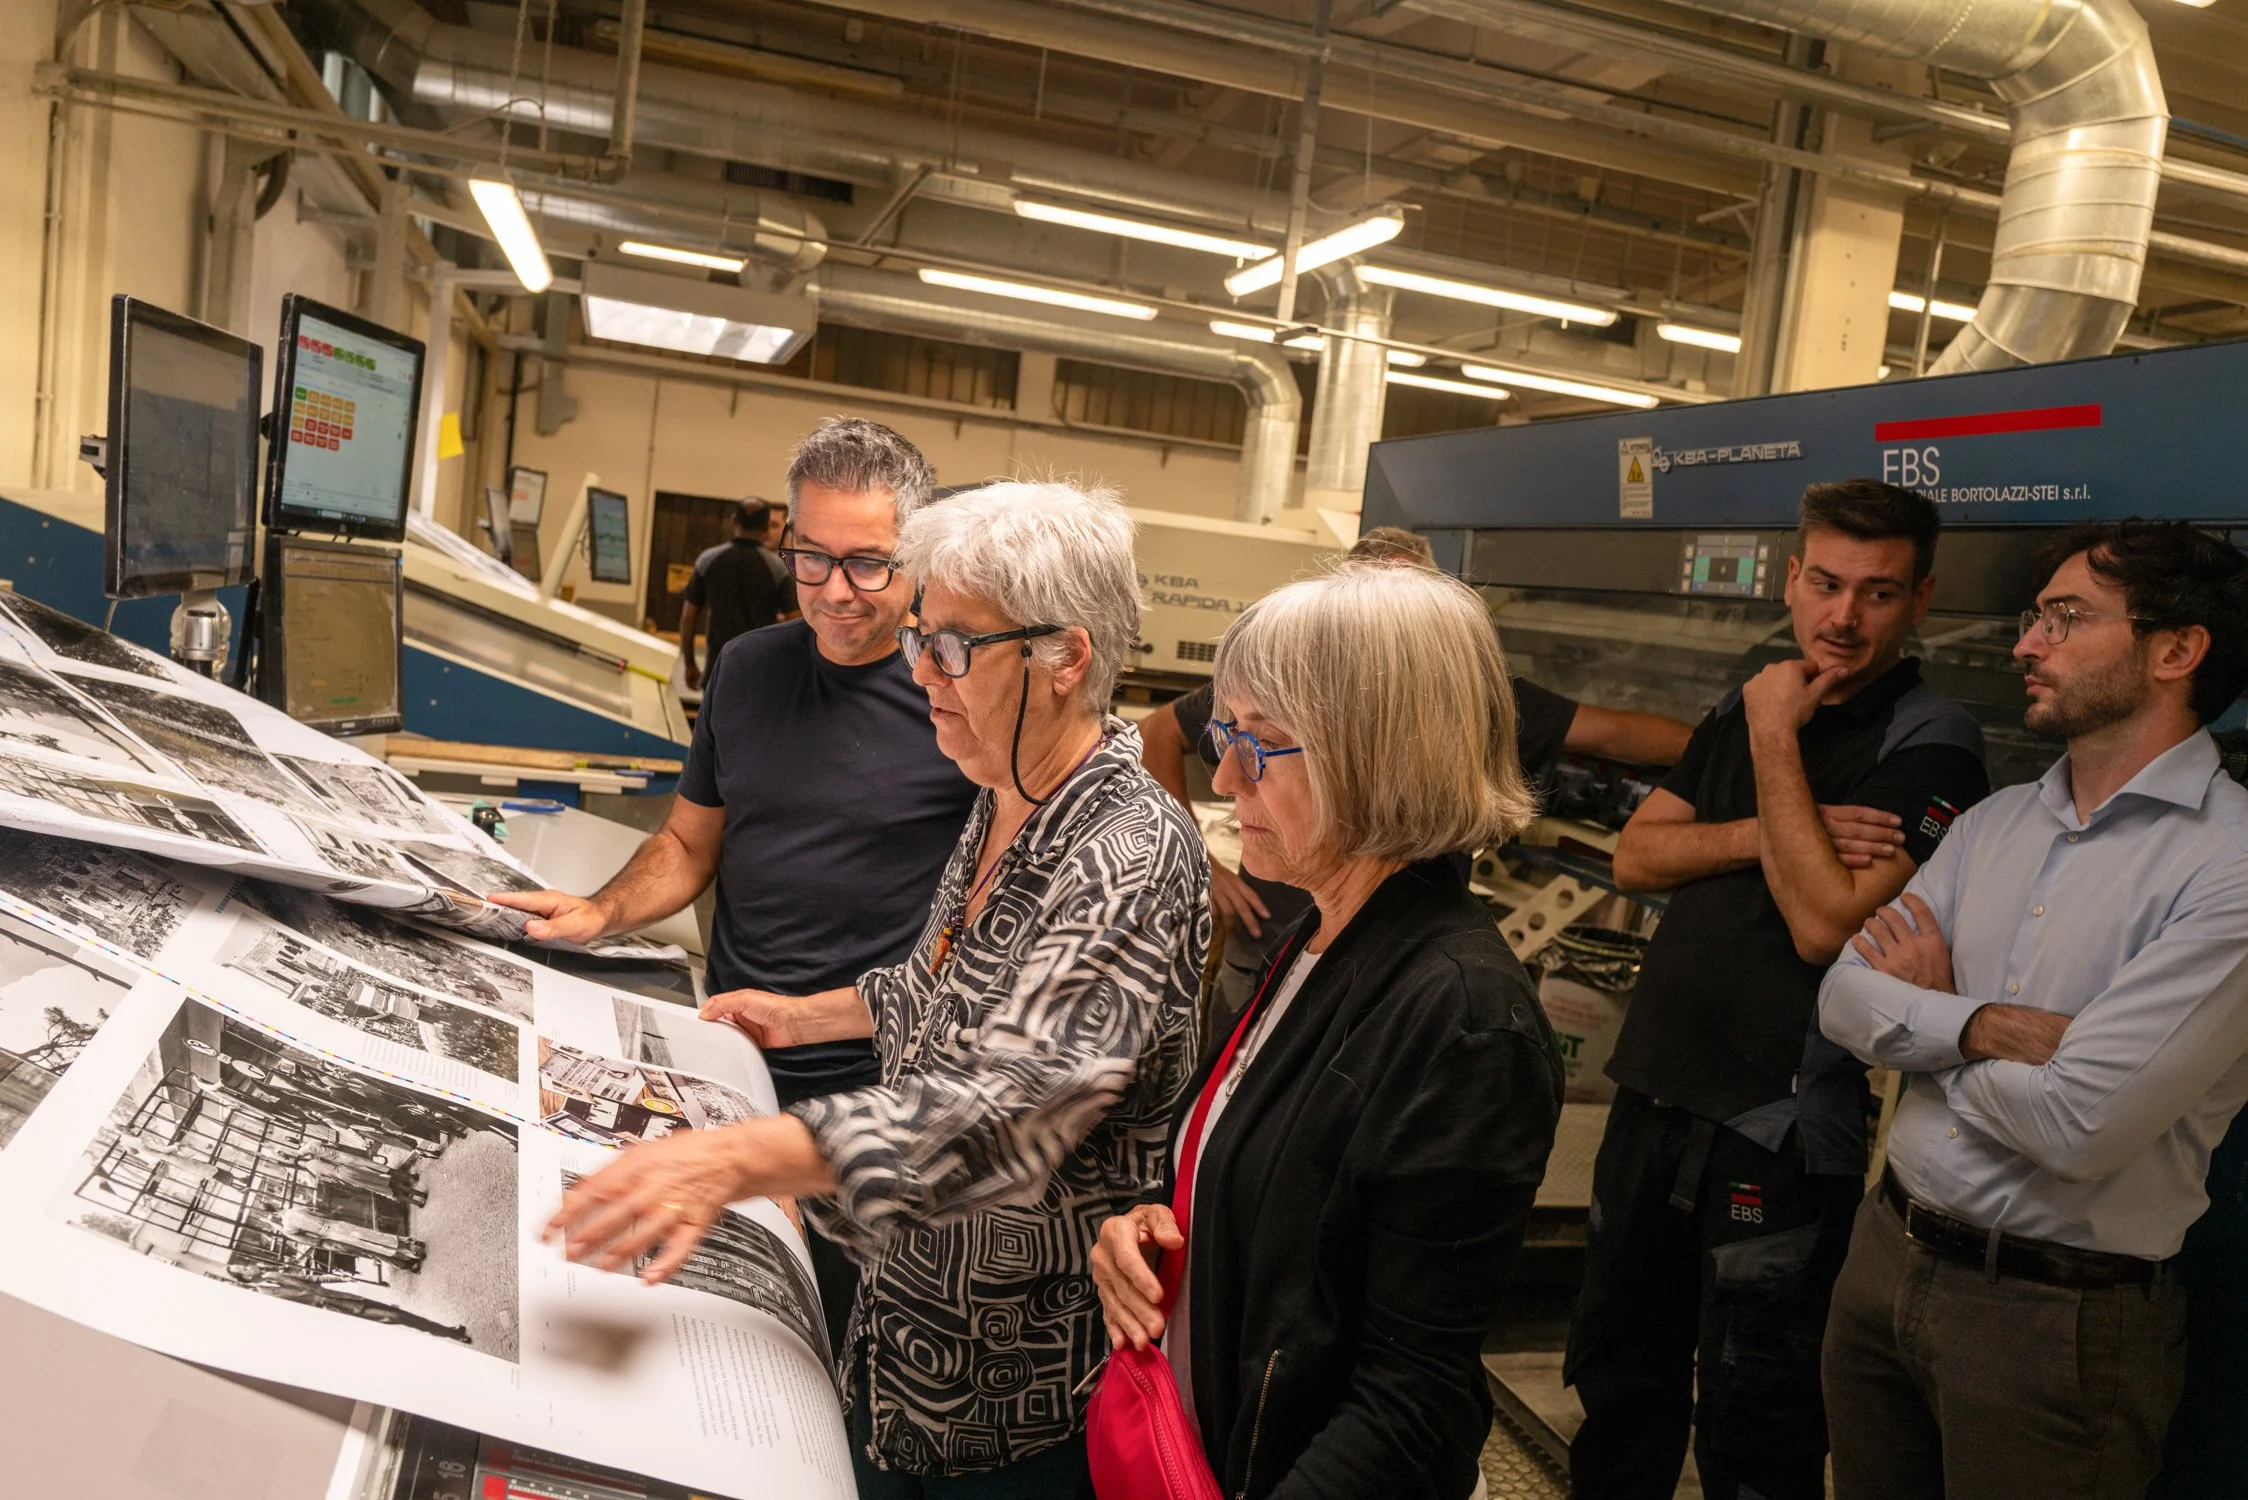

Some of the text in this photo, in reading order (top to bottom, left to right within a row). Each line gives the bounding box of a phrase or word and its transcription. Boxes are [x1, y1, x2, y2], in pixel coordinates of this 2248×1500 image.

[1674, 443, 1801, 466] KBA-PLANETA
[1883, 446, 1940, 487] EBS
[1951, 484, 2059, 502] BORTOLAZZI-STEI
[2063, 483, 2091, 500] s.r.l.
[1154, 574, 1199, 589] KBA
[1152, 591, 1230, 612] RAPIDA
[1920, 815, 1948, 841] EBS
[1731, 1203, 1763, 1224] EBS
